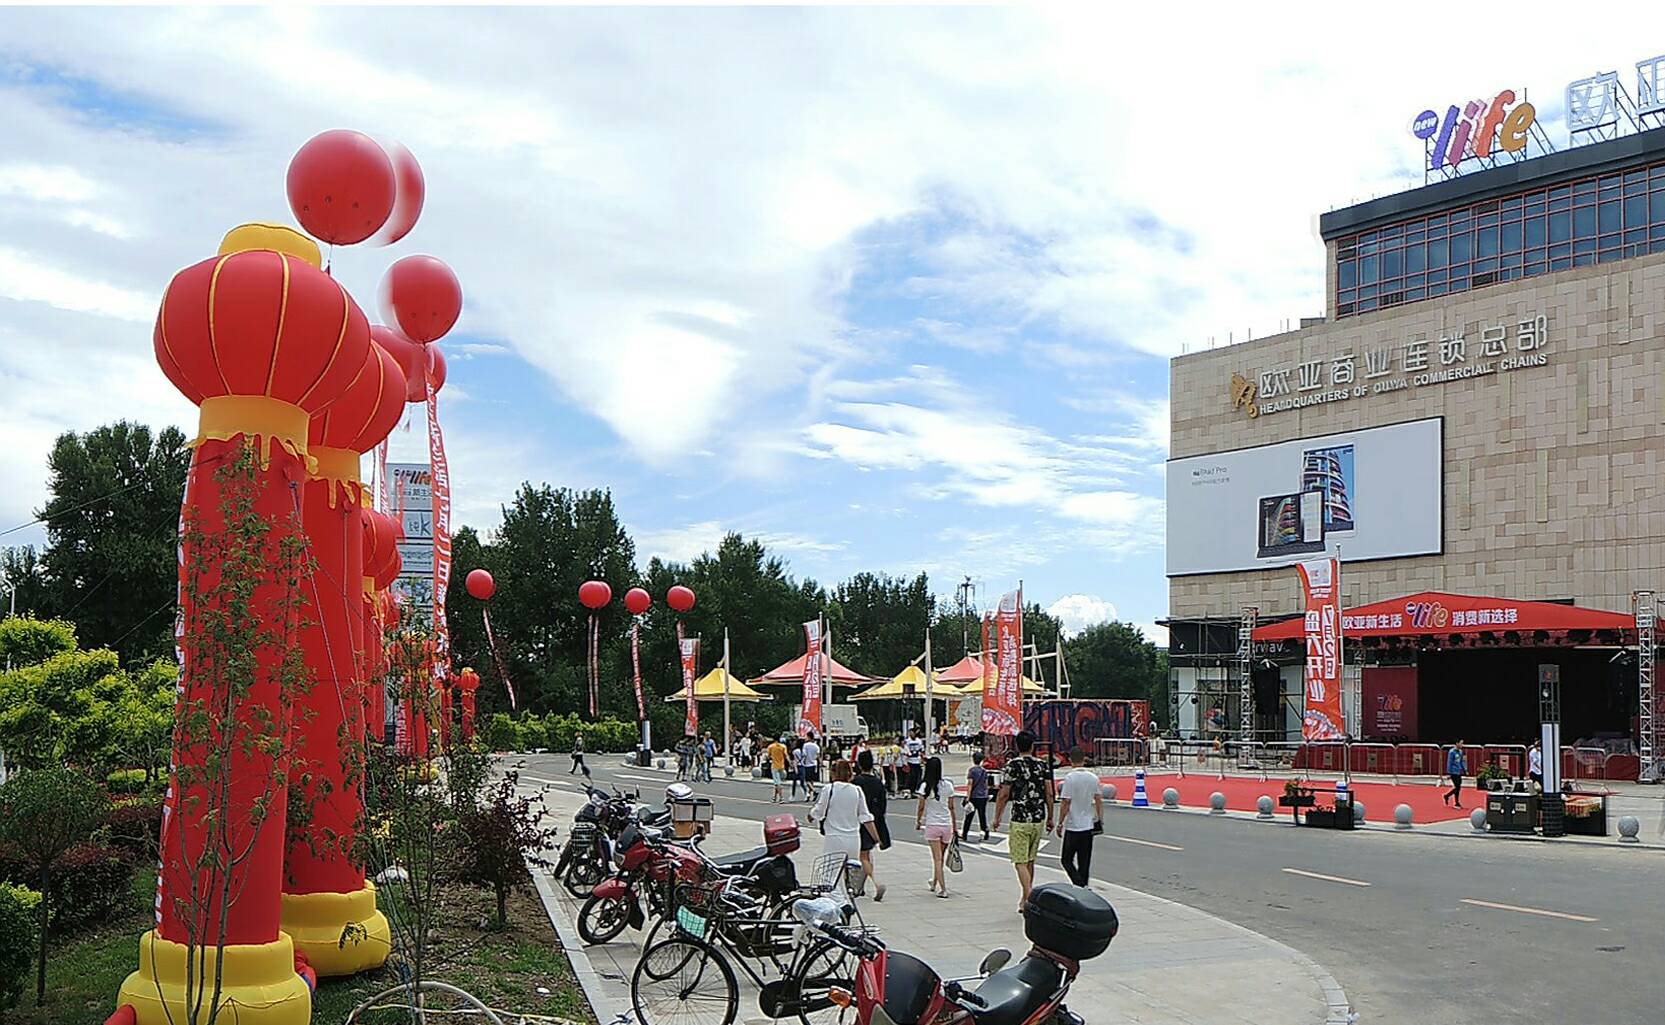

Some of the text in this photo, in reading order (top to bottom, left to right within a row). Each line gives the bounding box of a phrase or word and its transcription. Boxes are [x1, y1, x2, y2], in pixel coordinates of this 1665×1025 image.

[1431, 89, 1536, 170] life
[1259, 315, 1548, 398] 欧亚商业连锁总部
[1353, 384, 1368, 398] OF
[1500, 352, 1548, 370] CHAINS
[1452, 608, 1518, 627] 消费新选择
